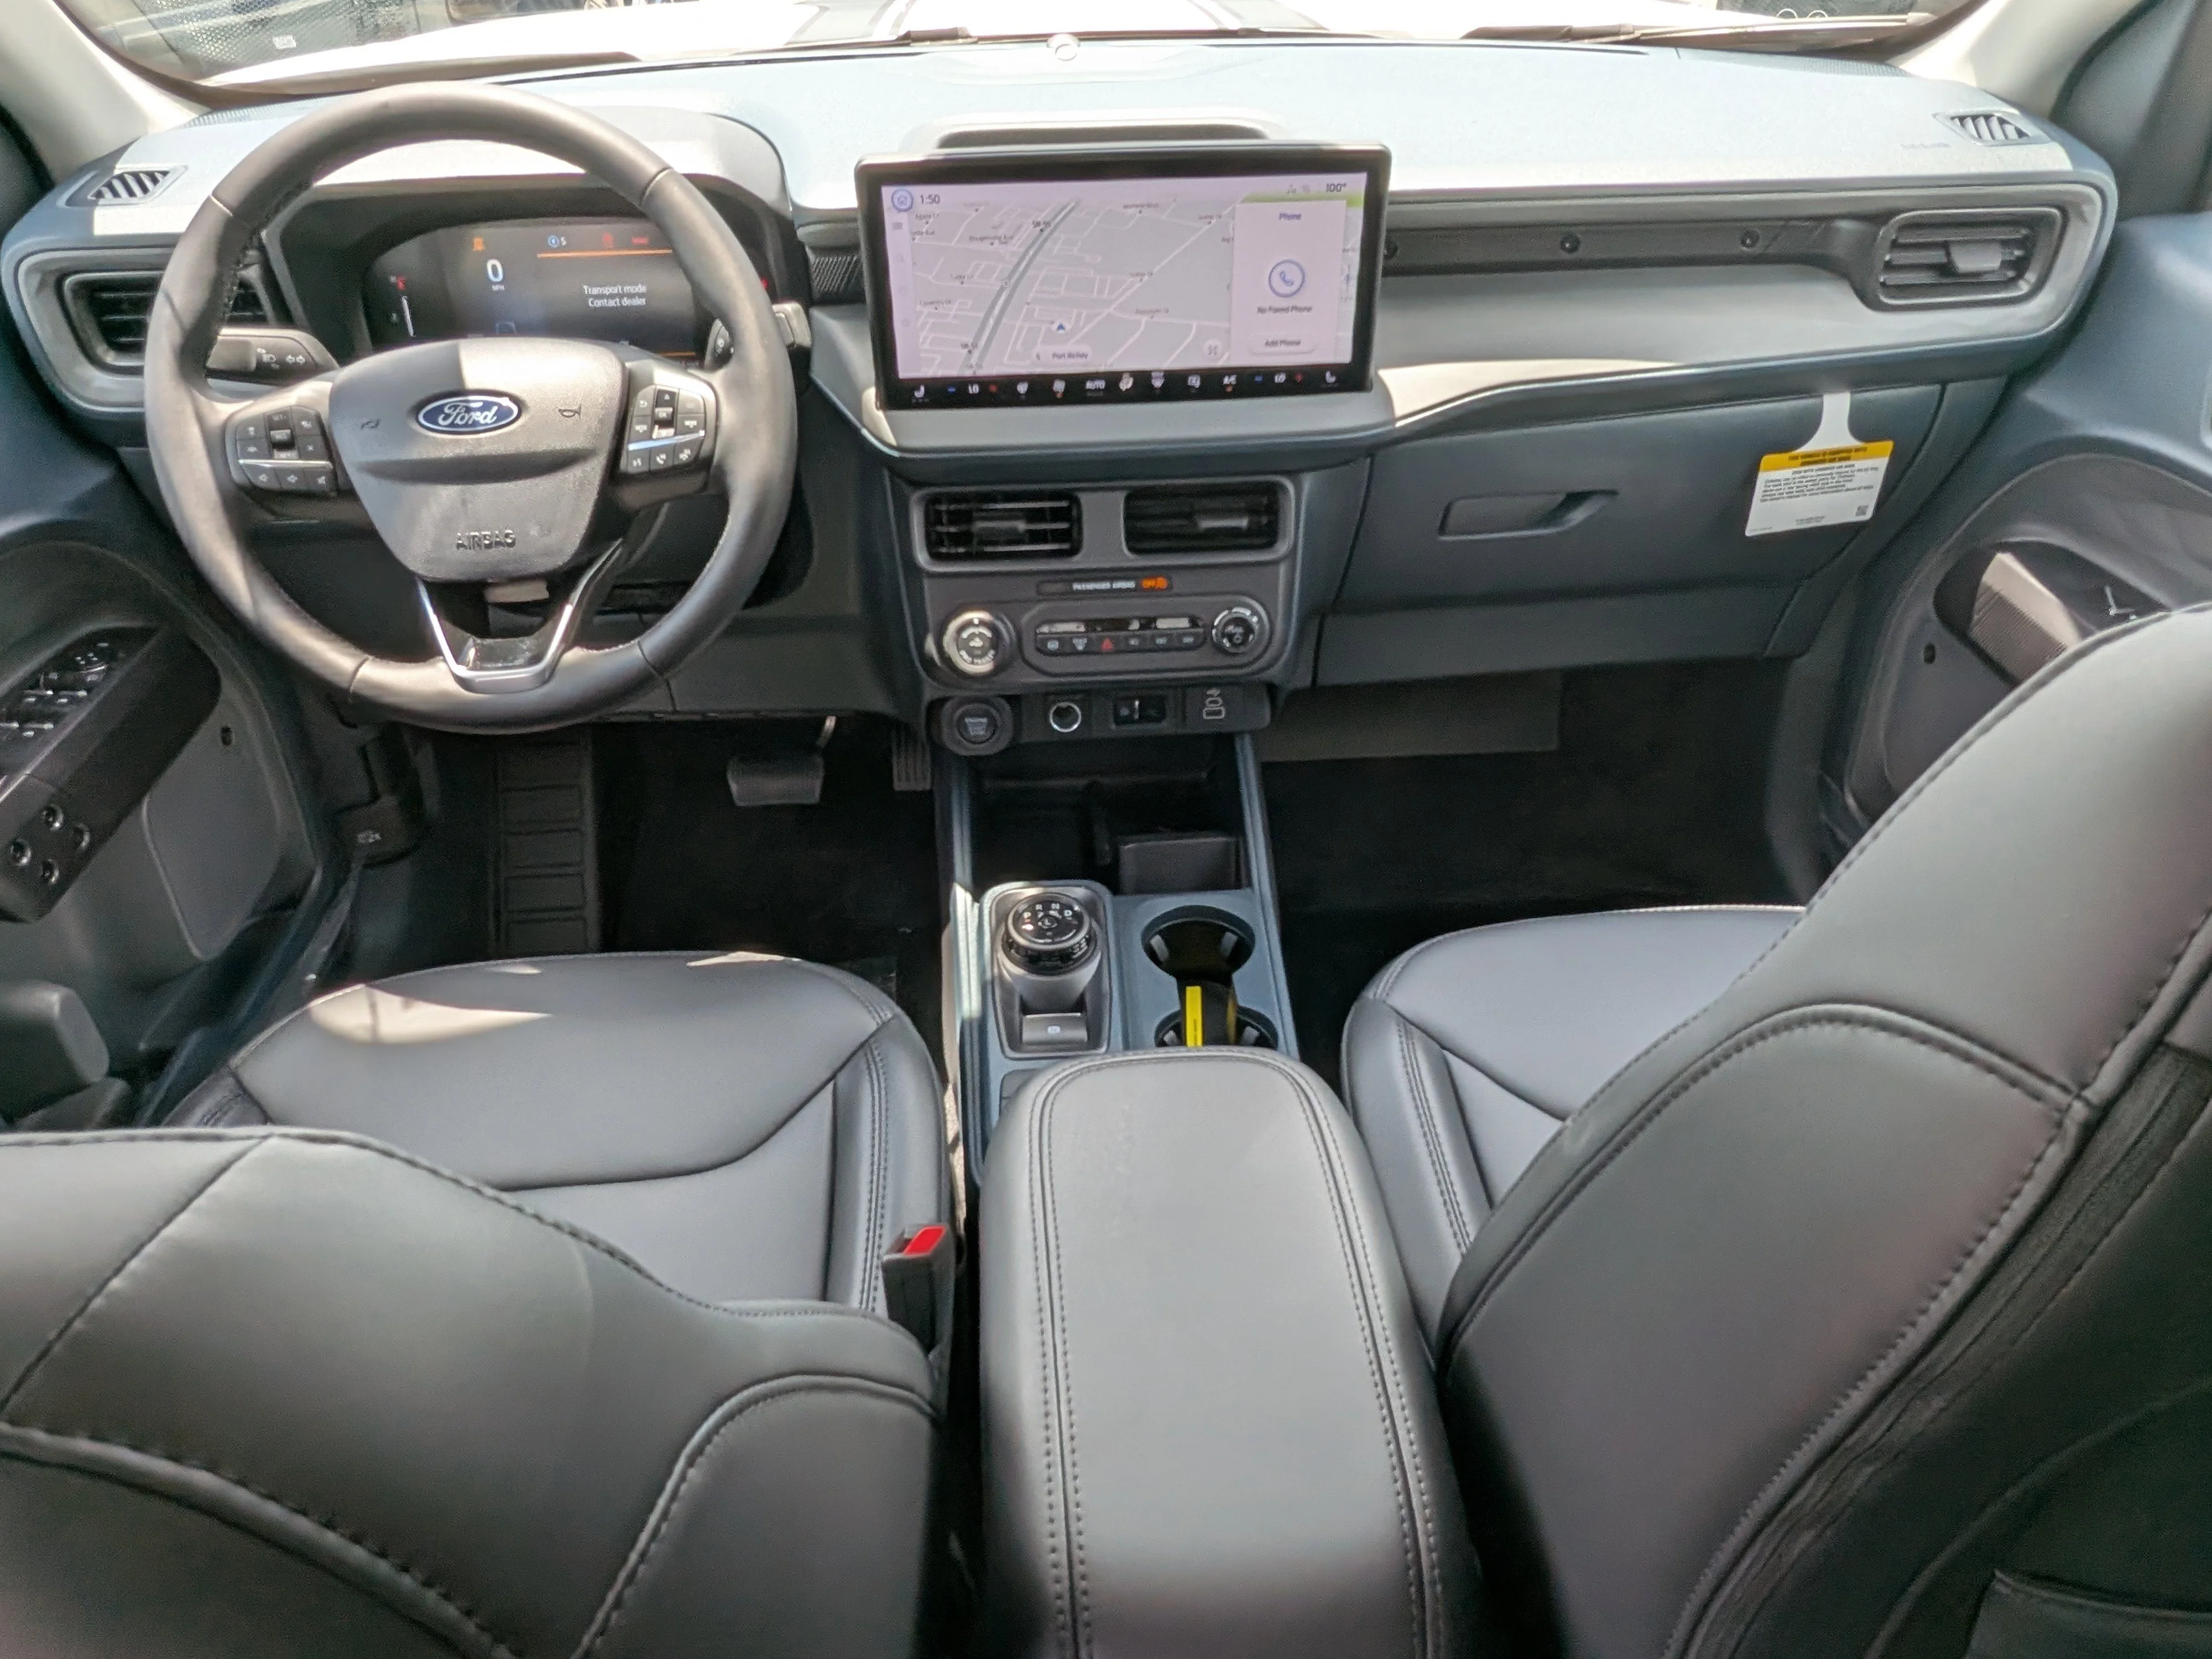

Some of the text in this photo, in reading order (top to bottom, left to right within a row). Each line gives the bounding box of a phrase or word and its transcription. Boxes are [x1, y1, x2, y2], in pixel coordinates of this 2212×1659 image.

[920, 194, 941, 205] 1:50
[486, 259, 503, 282] 0
[583, 284, 646, 295] Transport mode
[588, 296, 646, 307] Contact dealer
[1086, 379, 1105, 389] AUTO
[438, 402, 498, 425] Ford
[456, 529, 515, 550] AIRBAG
